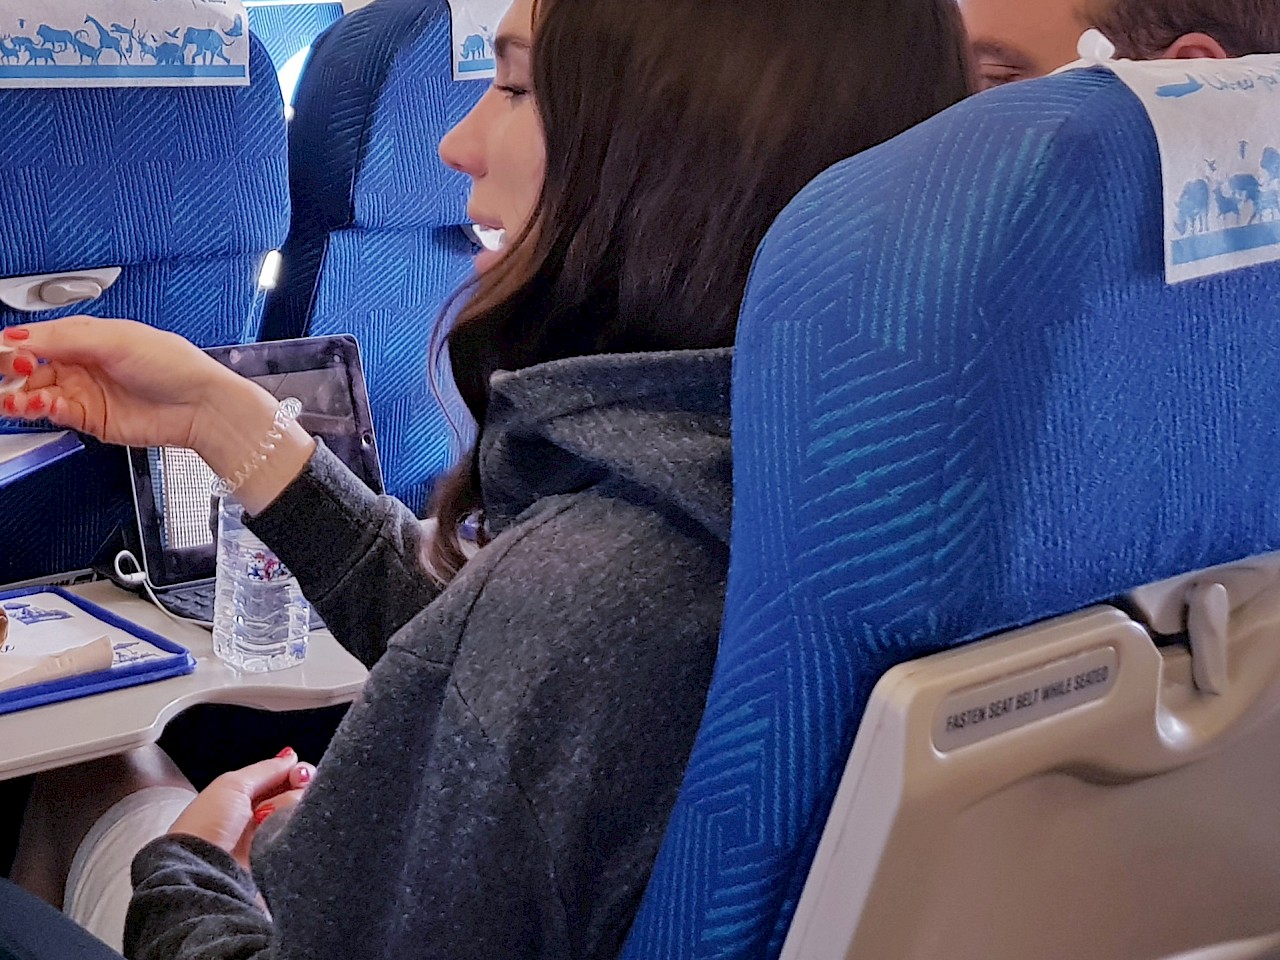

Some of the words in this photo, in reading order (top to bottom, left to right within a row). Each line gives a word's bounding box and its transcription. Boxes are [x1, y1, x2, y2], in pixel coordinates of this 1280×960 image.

[945, 705, 987, 732] FASTEN
[988, 696, 1013, 719] SEAT
[1015, 688, 1040, 711] BELT
[1042, 677, 1072, 702] WHILE
[1073, 665, 1109, 691] SEATED
